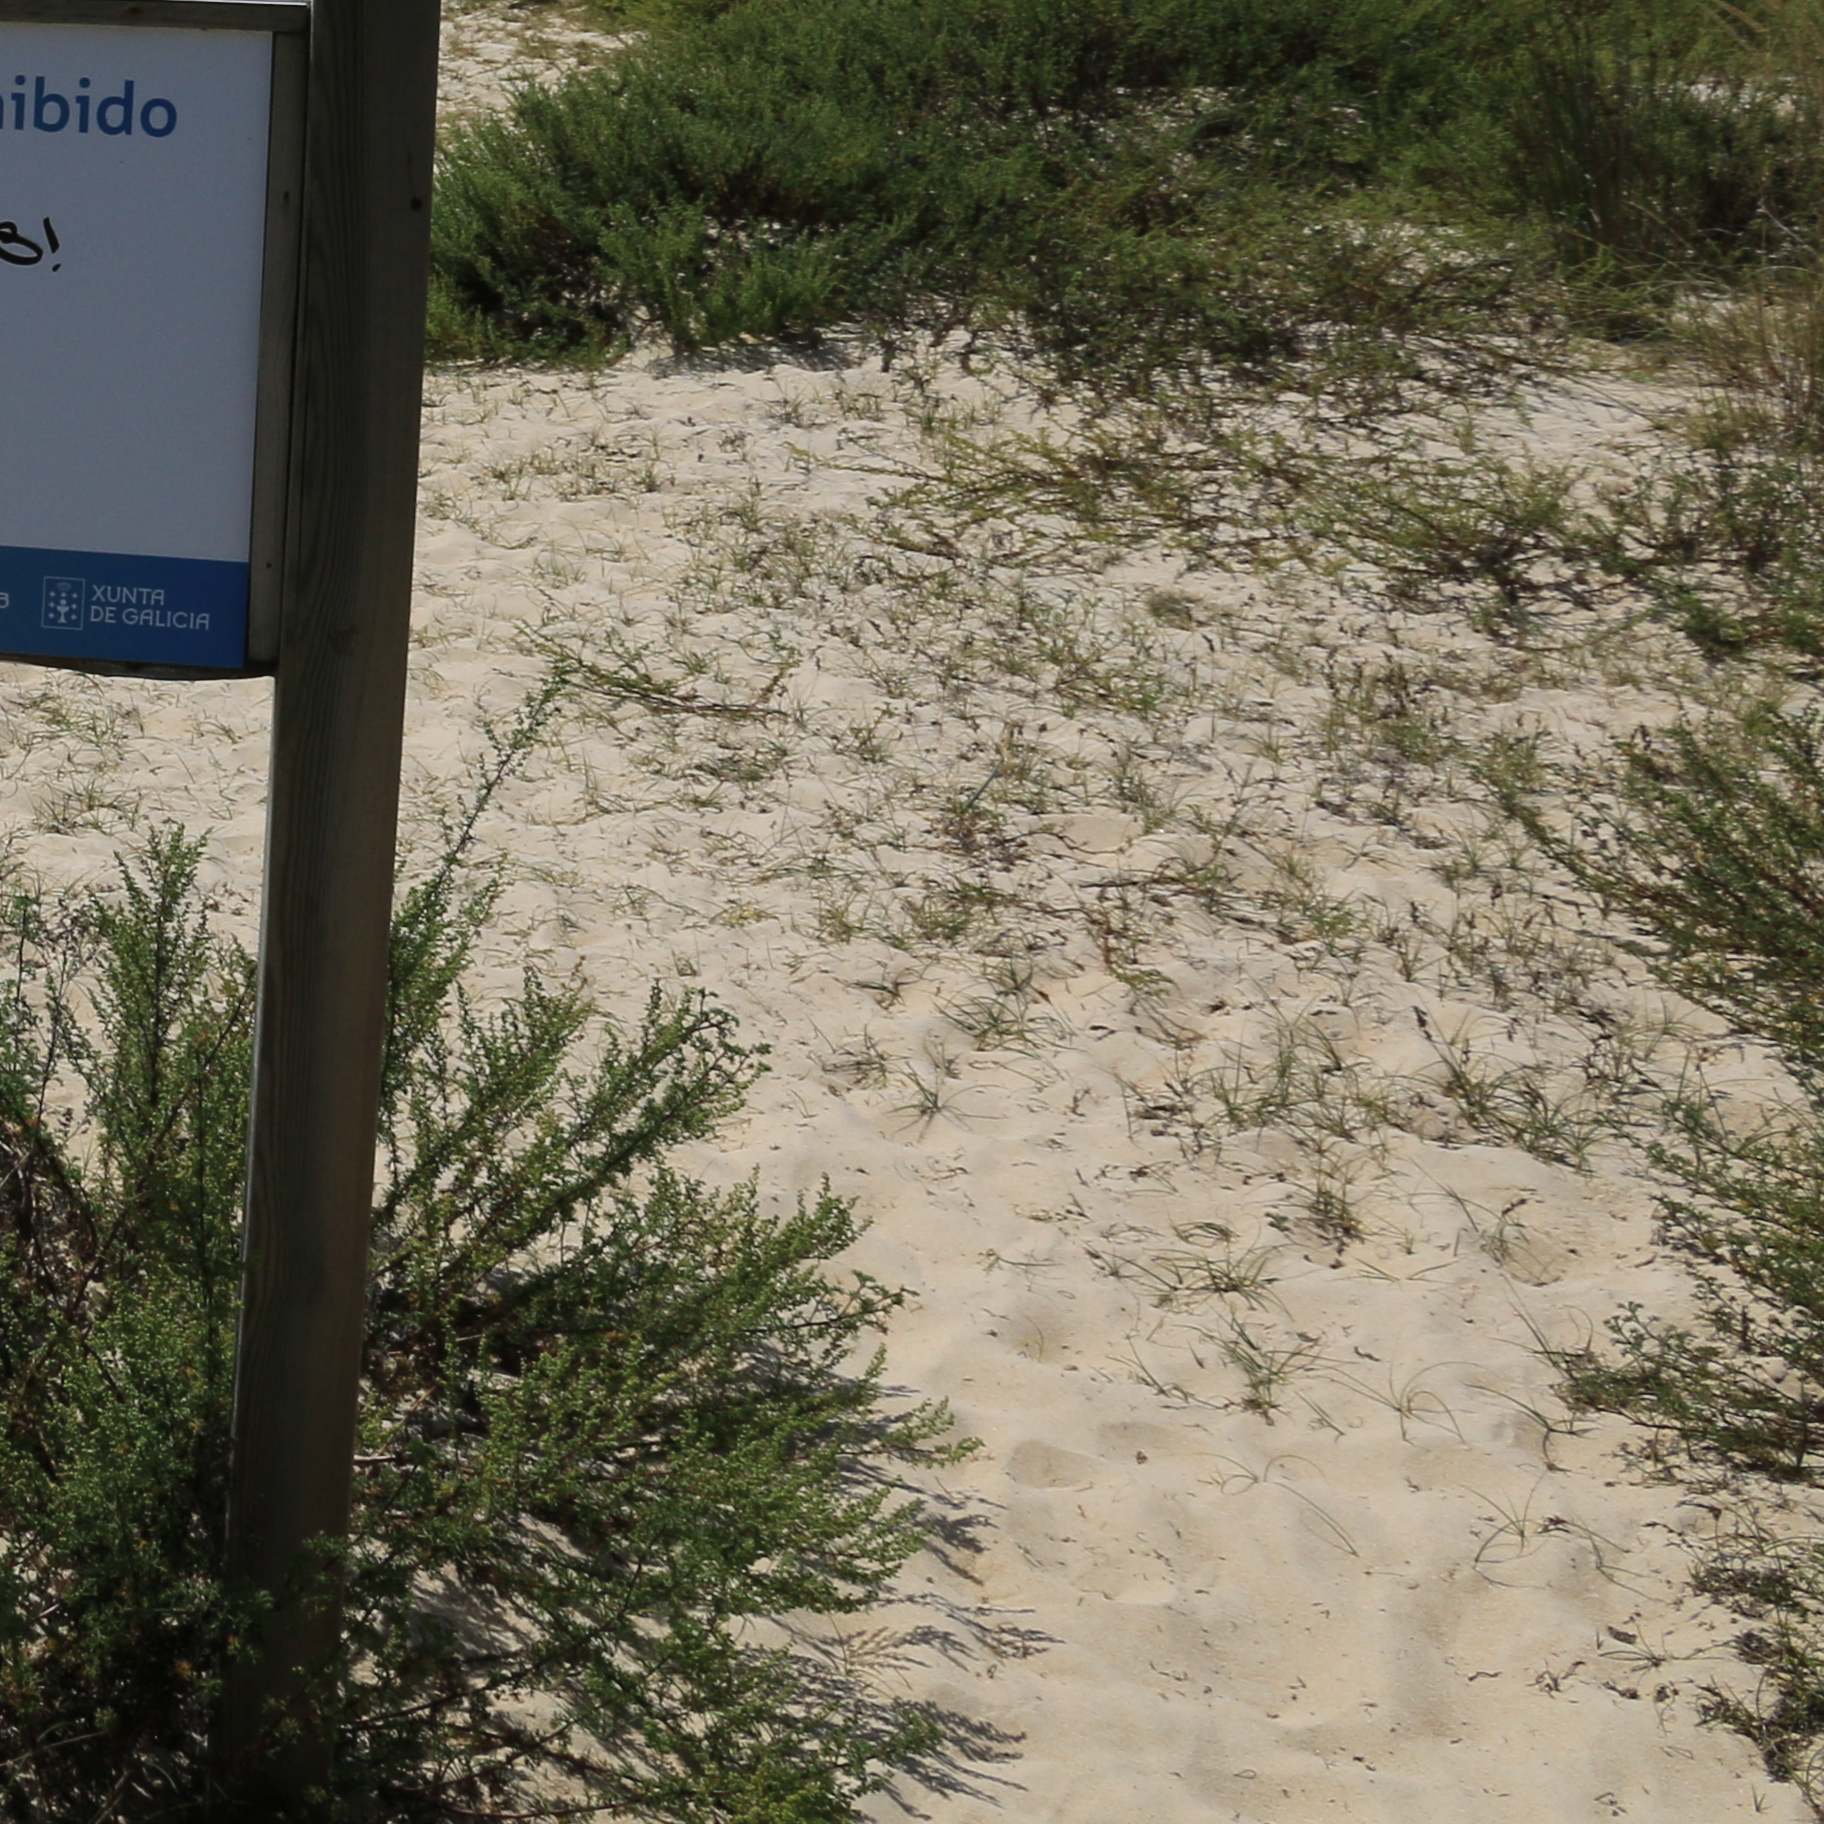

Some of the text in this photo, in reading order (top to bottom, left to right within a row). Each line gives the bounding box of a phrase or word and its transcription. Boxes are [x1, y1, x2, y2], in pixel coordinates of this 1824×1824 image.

[91, 584, 165, 606] XUNTA
[90, 605, 210, 630] DE GALICIA
